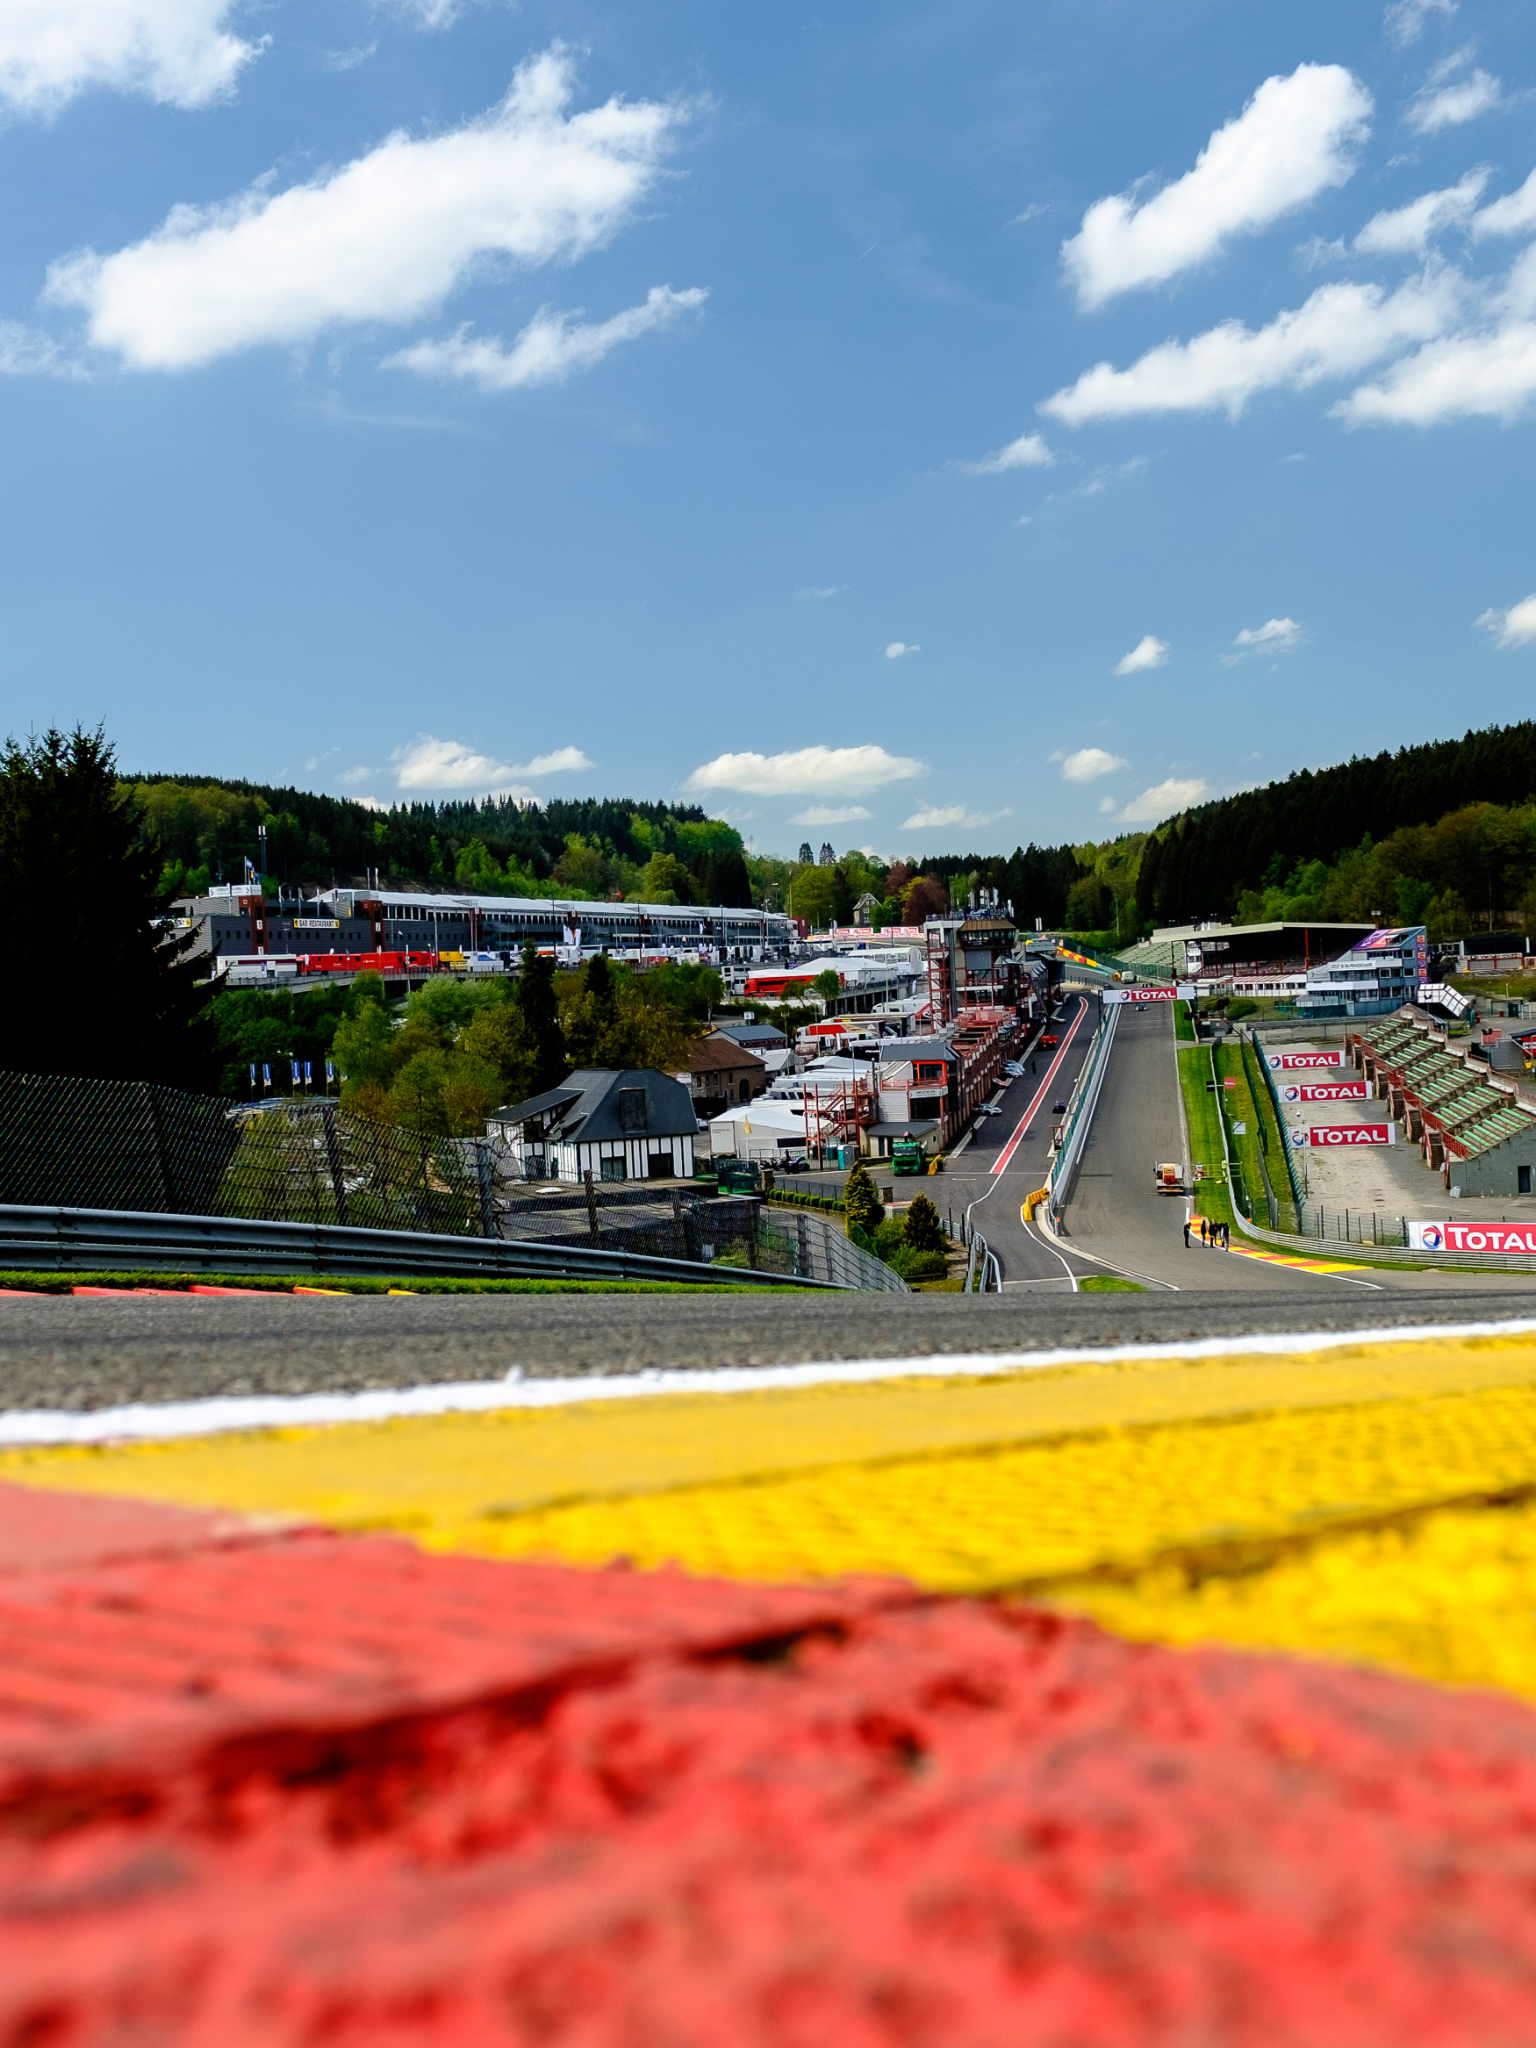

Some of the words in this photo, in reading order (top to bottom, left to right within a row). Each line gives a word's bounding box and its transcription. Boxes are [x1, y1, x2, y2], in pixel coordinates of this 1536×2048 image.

[1132, 990, 1176, 1000] TOTAL
[1284, 1055, 1339, 1067] TOTAL
[1302, 1086, 1365, 1099] TOTAL
[1312, 1128, 1386, 1144] TOTAL
